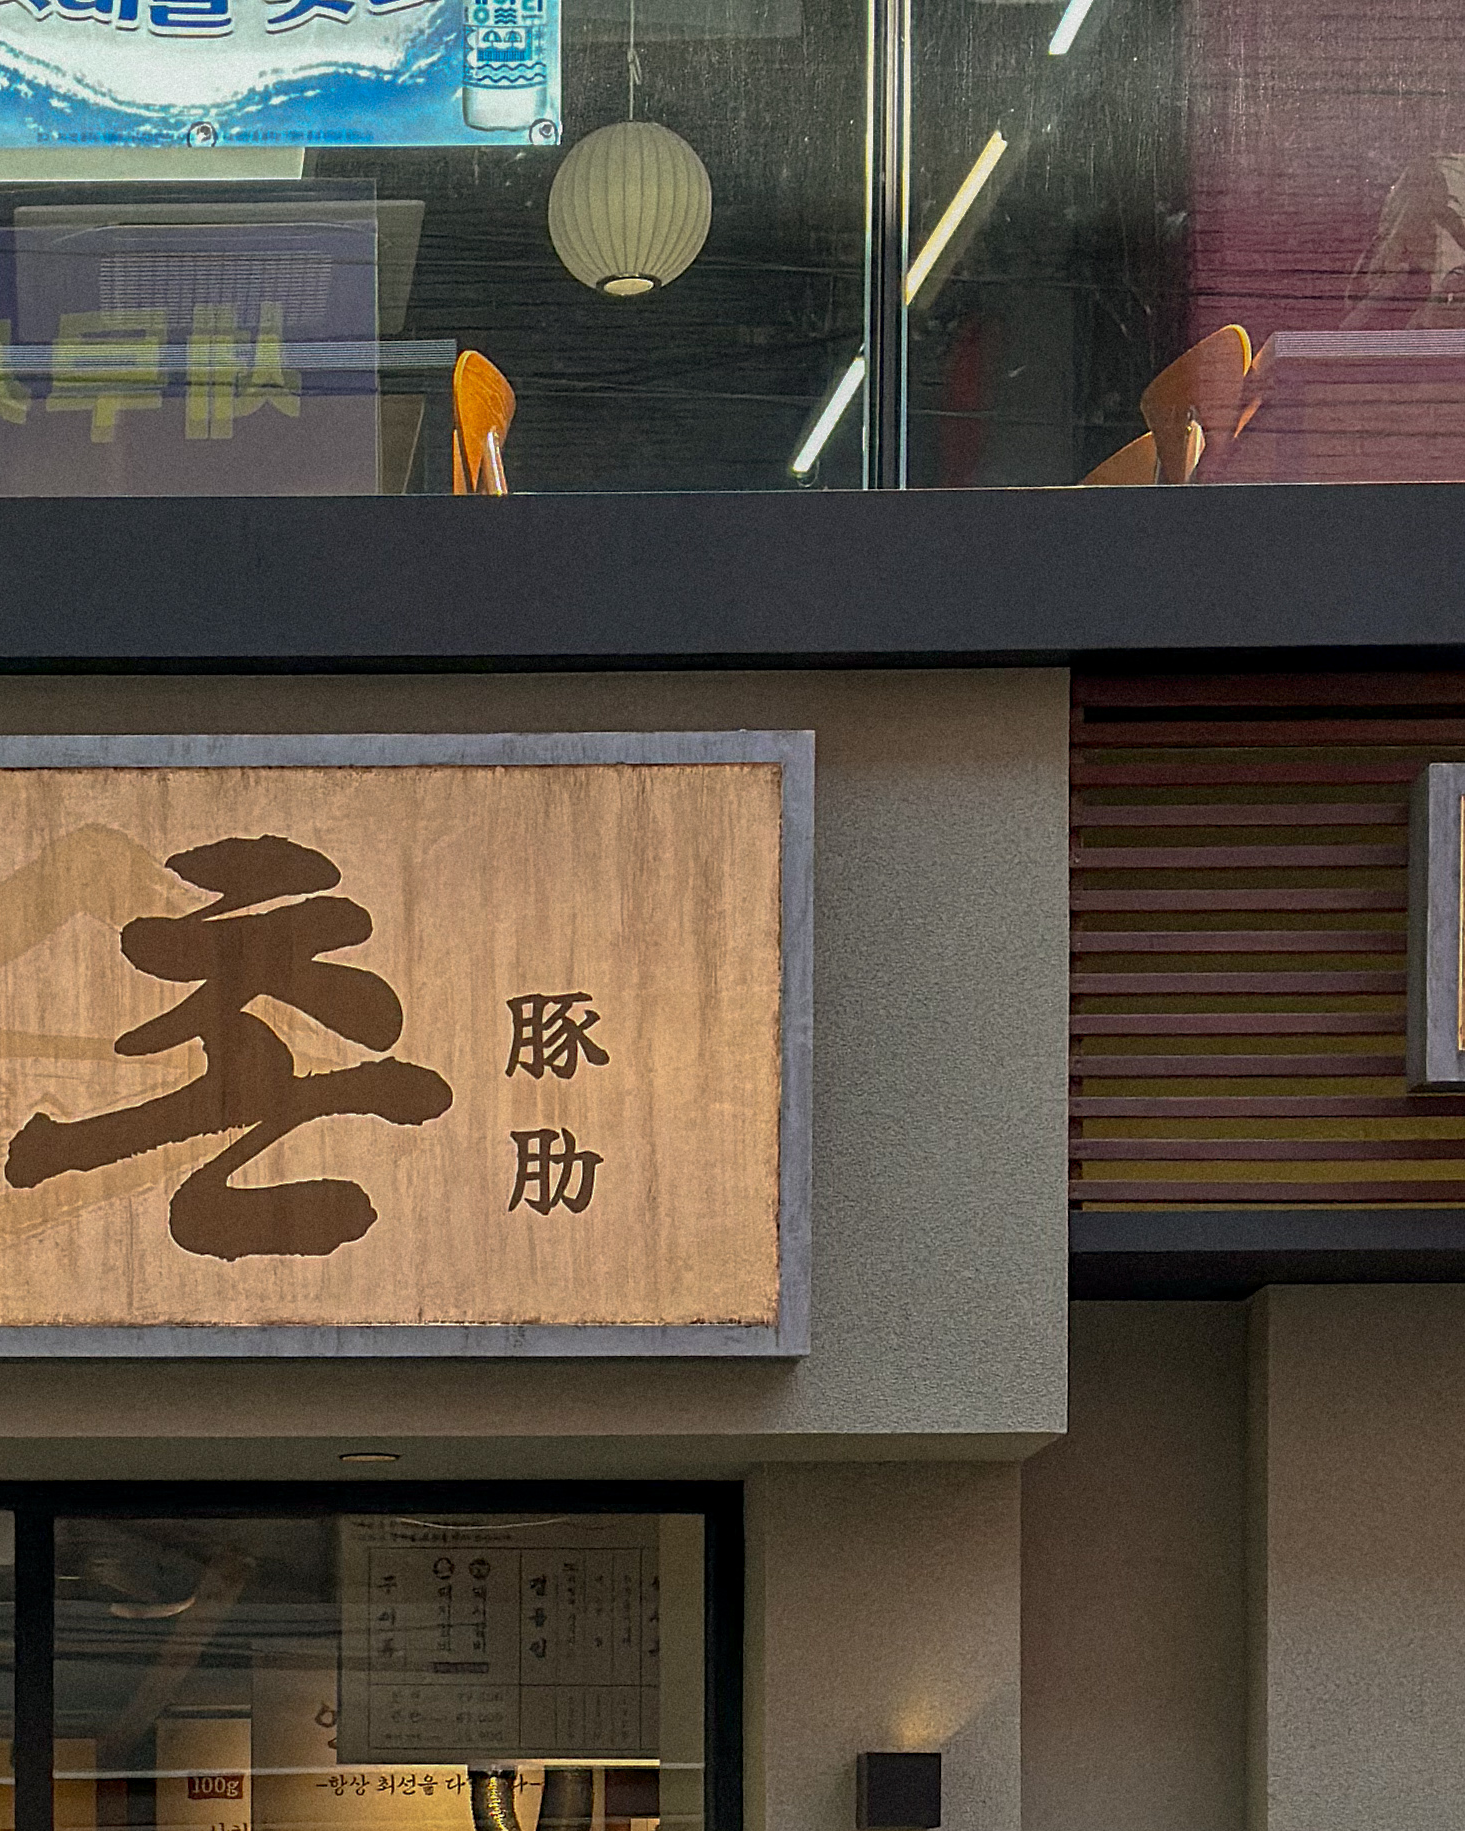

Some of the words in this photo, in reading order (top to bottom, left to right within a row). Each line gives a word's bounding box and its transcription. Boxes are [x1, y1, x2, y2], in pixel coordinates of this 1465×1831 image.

[506, 992, 609, 1215] 豚肋
[191, 1778, 240, 1798] 100g
[376, 1774, 438, 1795] 최선을
